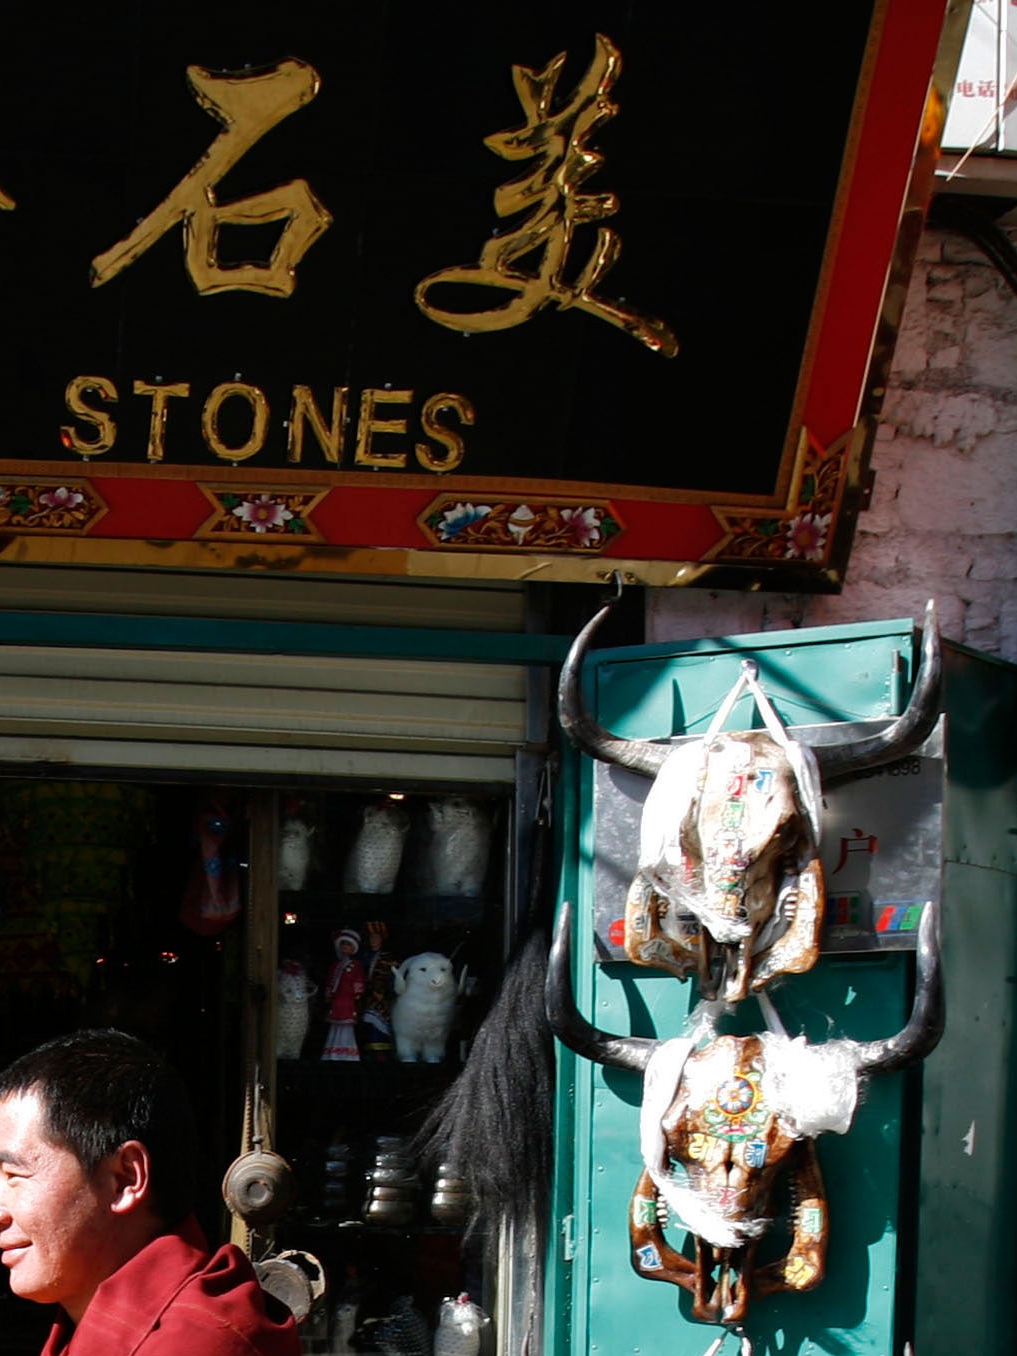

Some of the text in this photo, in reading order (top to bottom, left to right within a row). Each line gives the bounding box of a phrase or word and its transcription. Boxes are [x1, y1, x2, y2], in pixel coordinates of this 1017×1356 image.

[957, 79, 996, 98] 电话
[60, 375, 476, 473] STONES
[831, 828, 879, 875] 户
